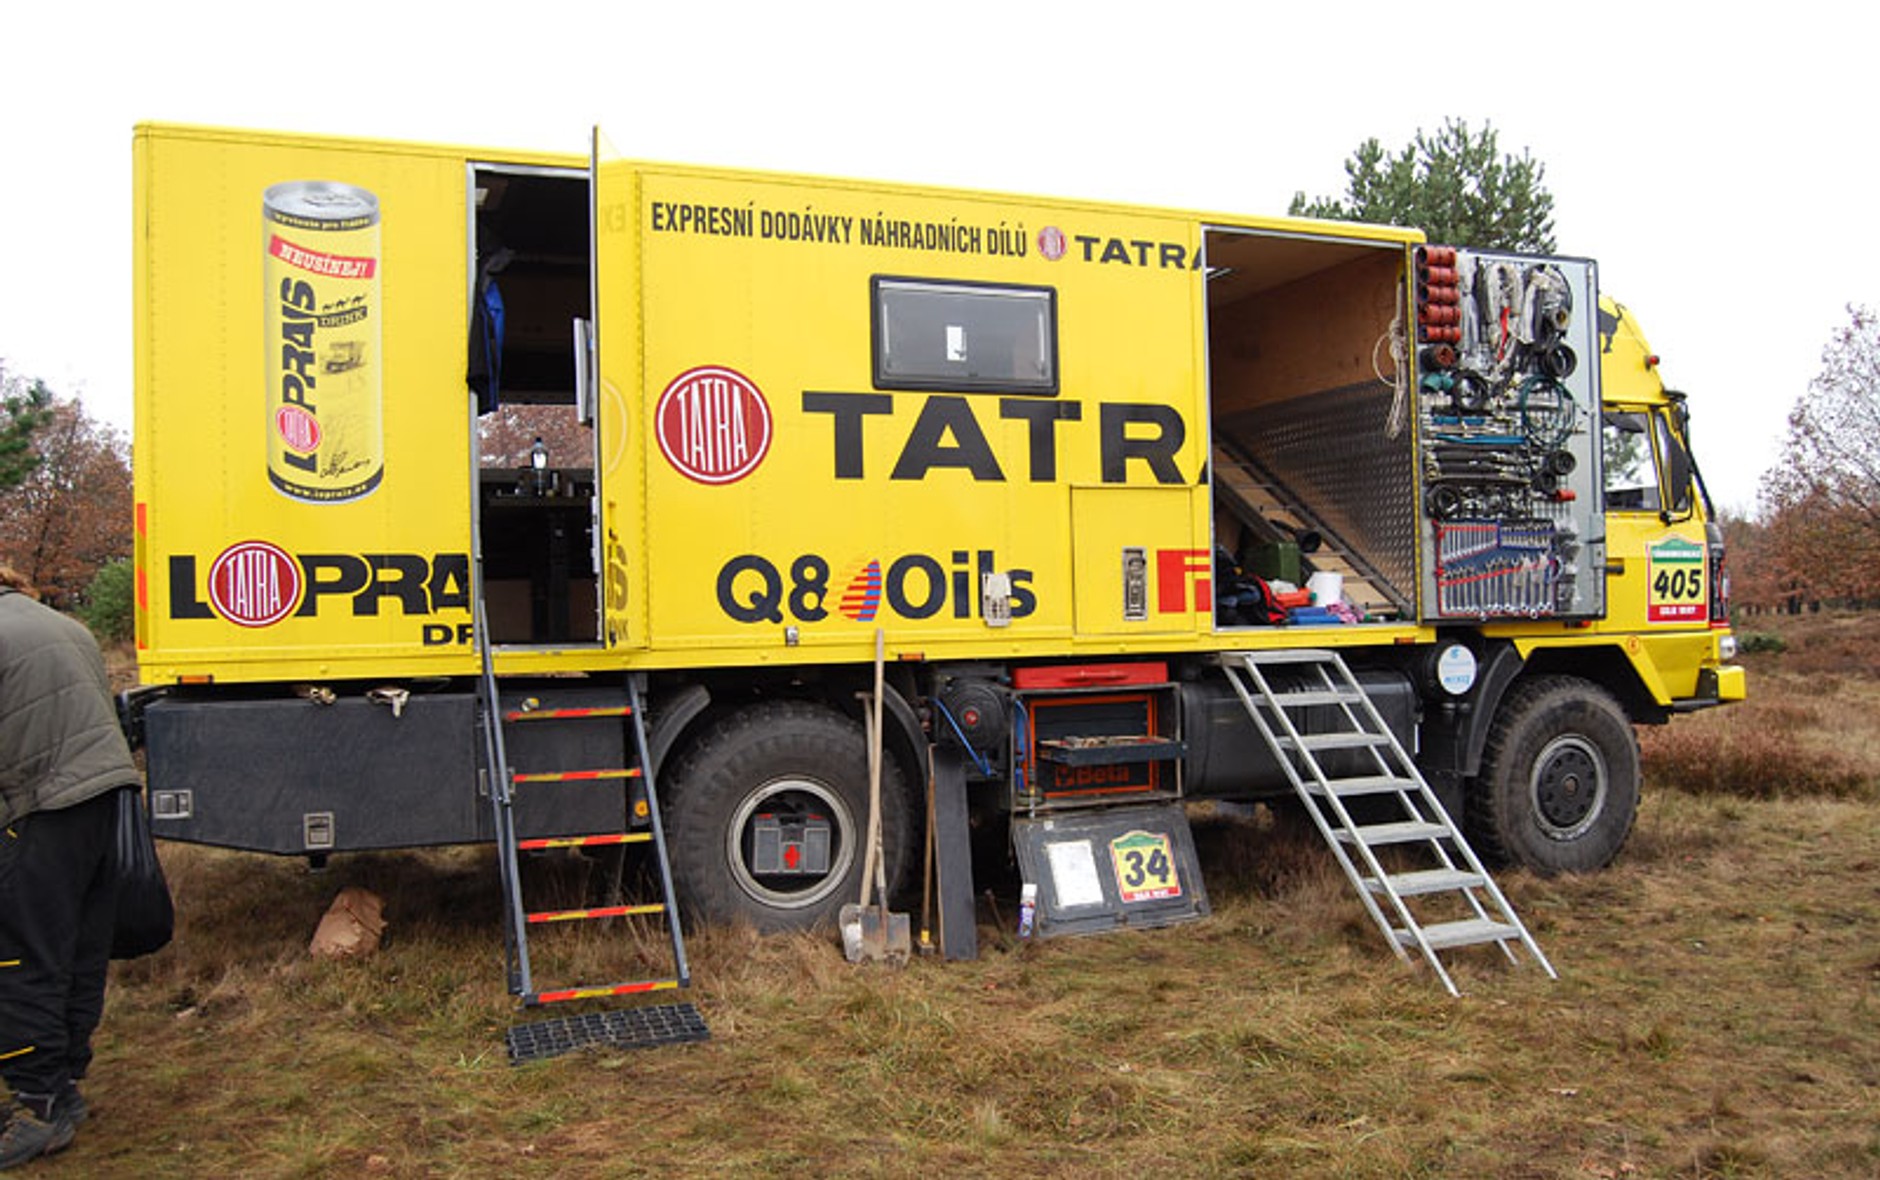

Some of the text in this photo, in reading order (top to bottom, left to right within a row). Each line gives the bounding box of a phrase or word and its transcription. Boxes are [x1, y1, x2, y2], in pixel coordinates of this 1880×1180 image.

[651, 200, 754, 237] EXPRESNÍ
[760, 205, 853, 244] DODÁVKY
[860, 211, 982, 254] NÁHRADNÍCH
[986, 220, 1028, 257] DÍLŮ
[676, 377, 749, 474] TATRA
[801, 391, 1208, 485] TATR
[716, 553, 831, 624] Q8
[1653, 568, 1702, 600] 405
[1125, 848, 1170, 887] 34
